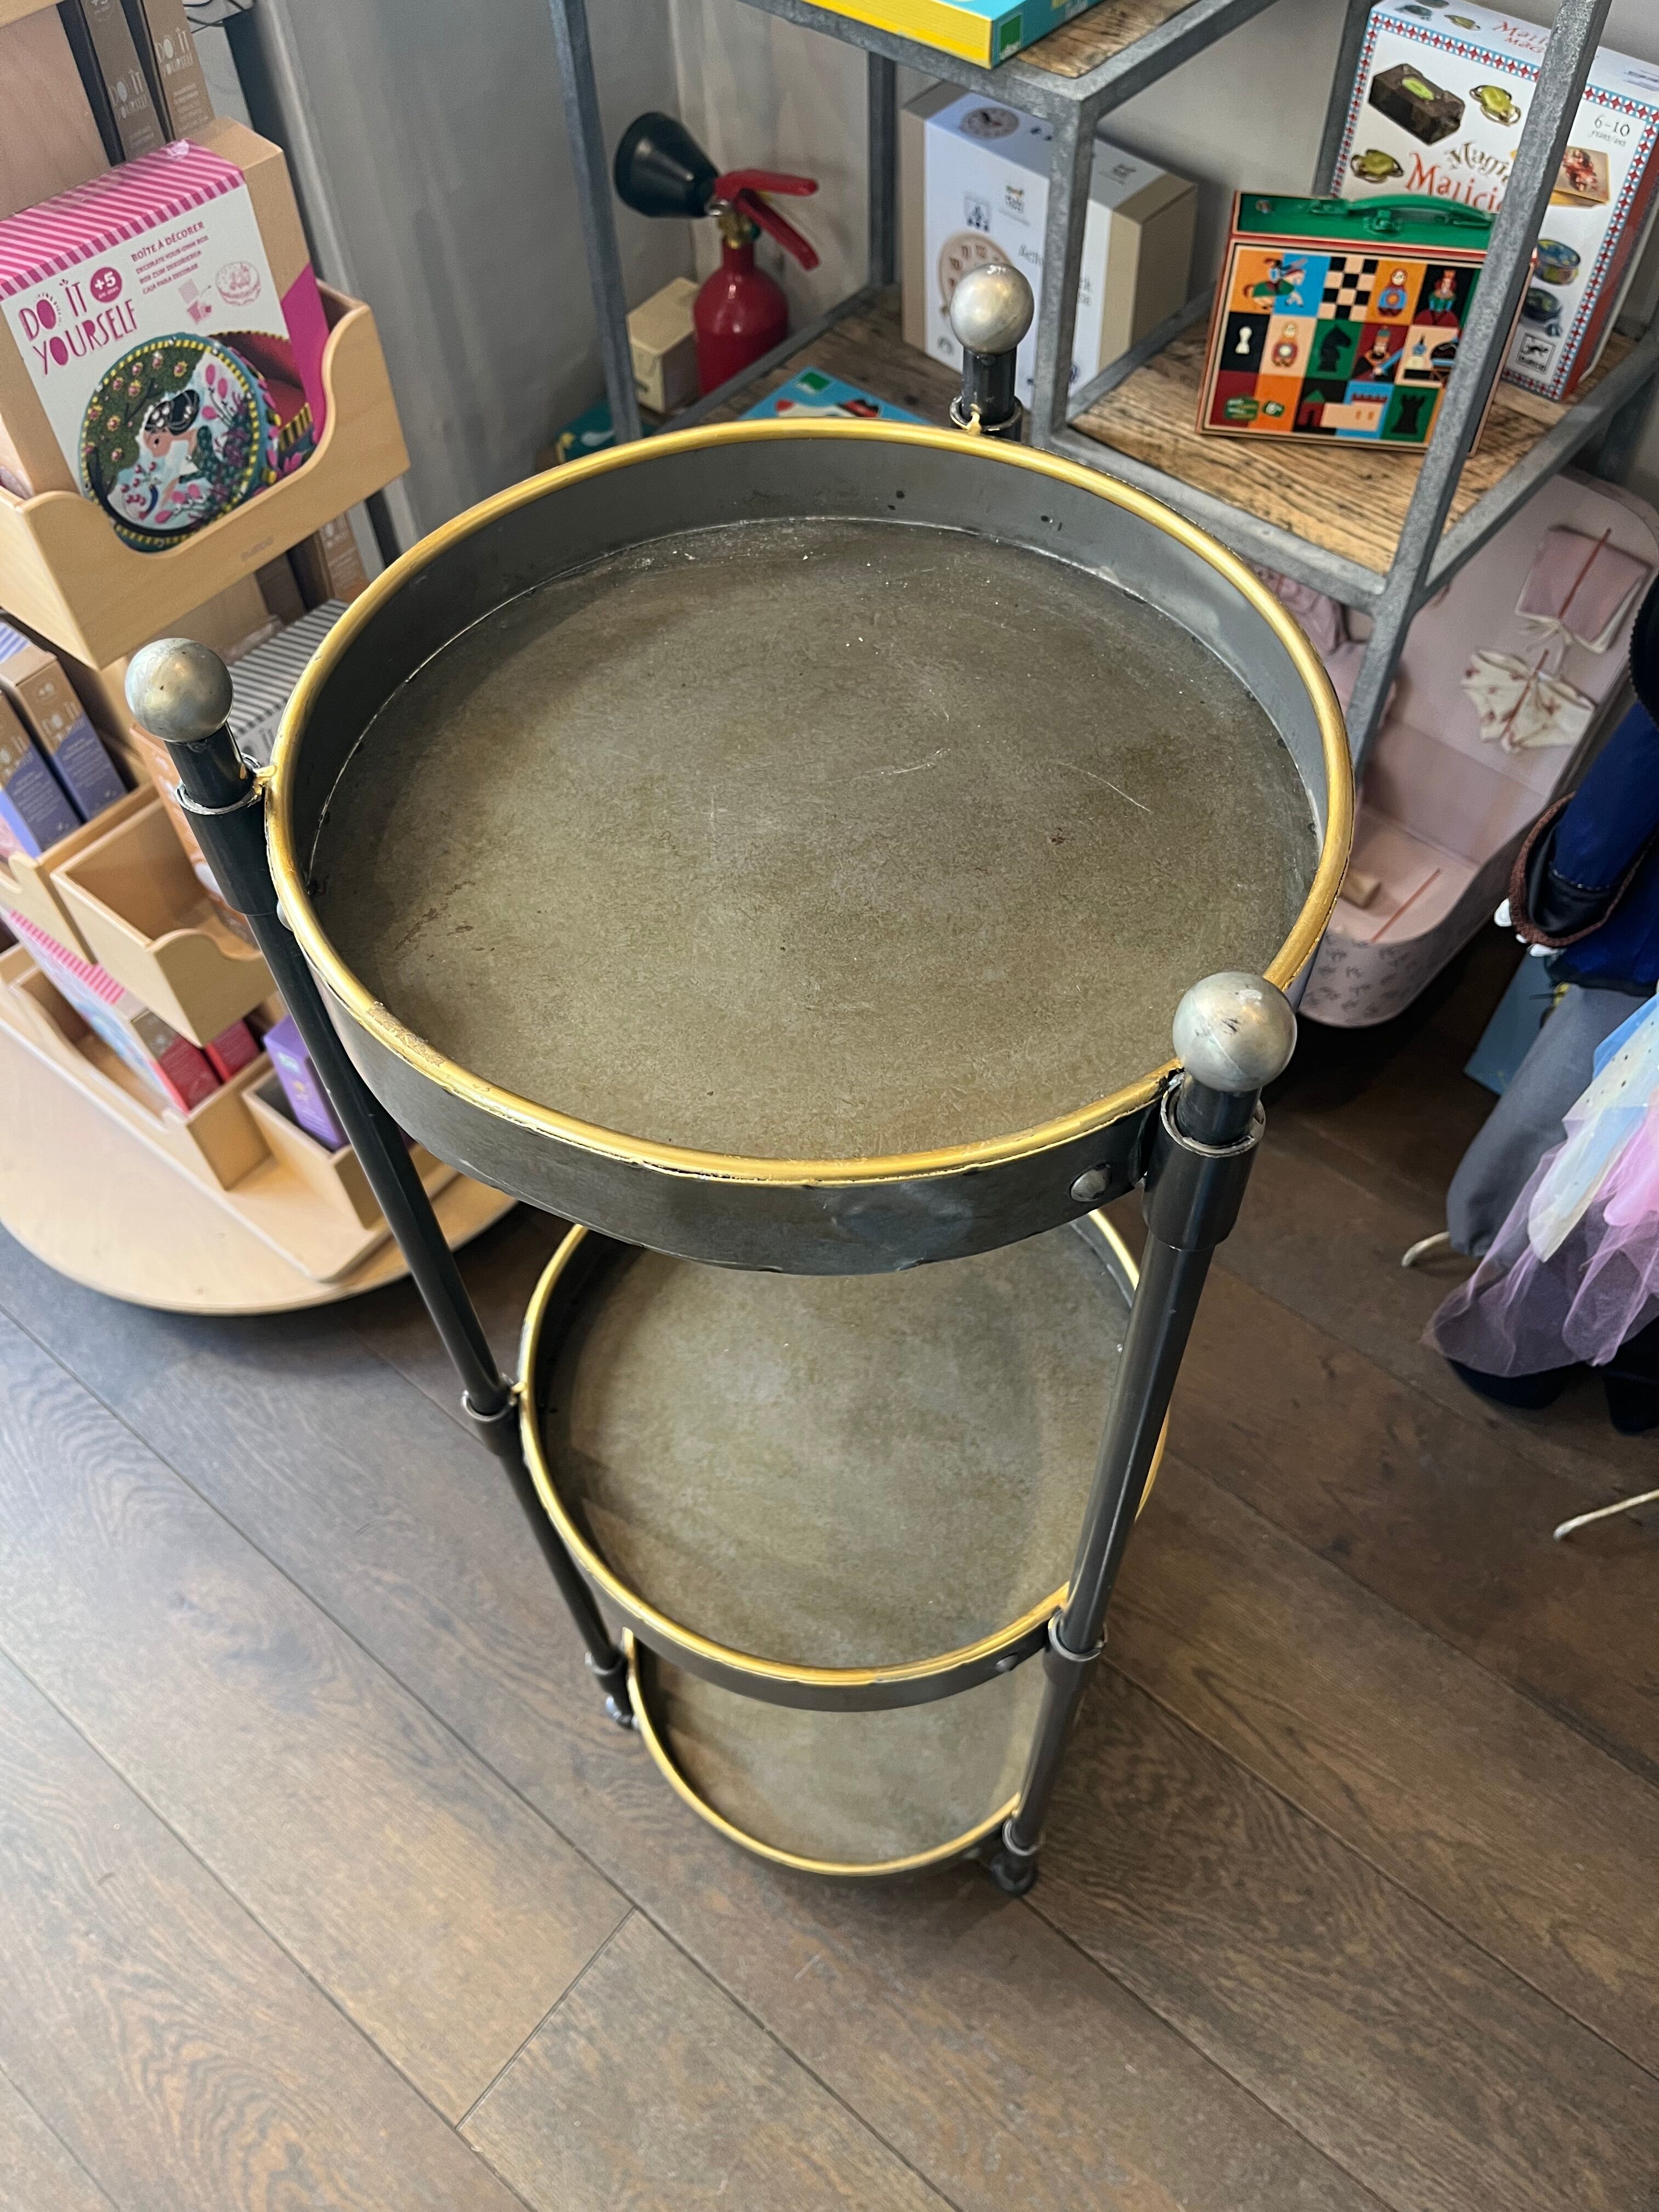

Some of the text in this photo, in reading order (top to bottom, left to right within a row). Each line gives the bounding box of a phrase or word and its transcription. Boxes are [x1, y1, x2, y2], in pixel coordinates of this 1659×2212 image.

[1594, 114, 1630, 137] 6-10
[131, 245, 156, 262] BOÎTE
[165, 221, 205, 246] DÉCORER
[94, 271, 117, 291] +5
[19, 280, 87, 342] DO IT
[32, 297, 138, 375] YOURSELF
